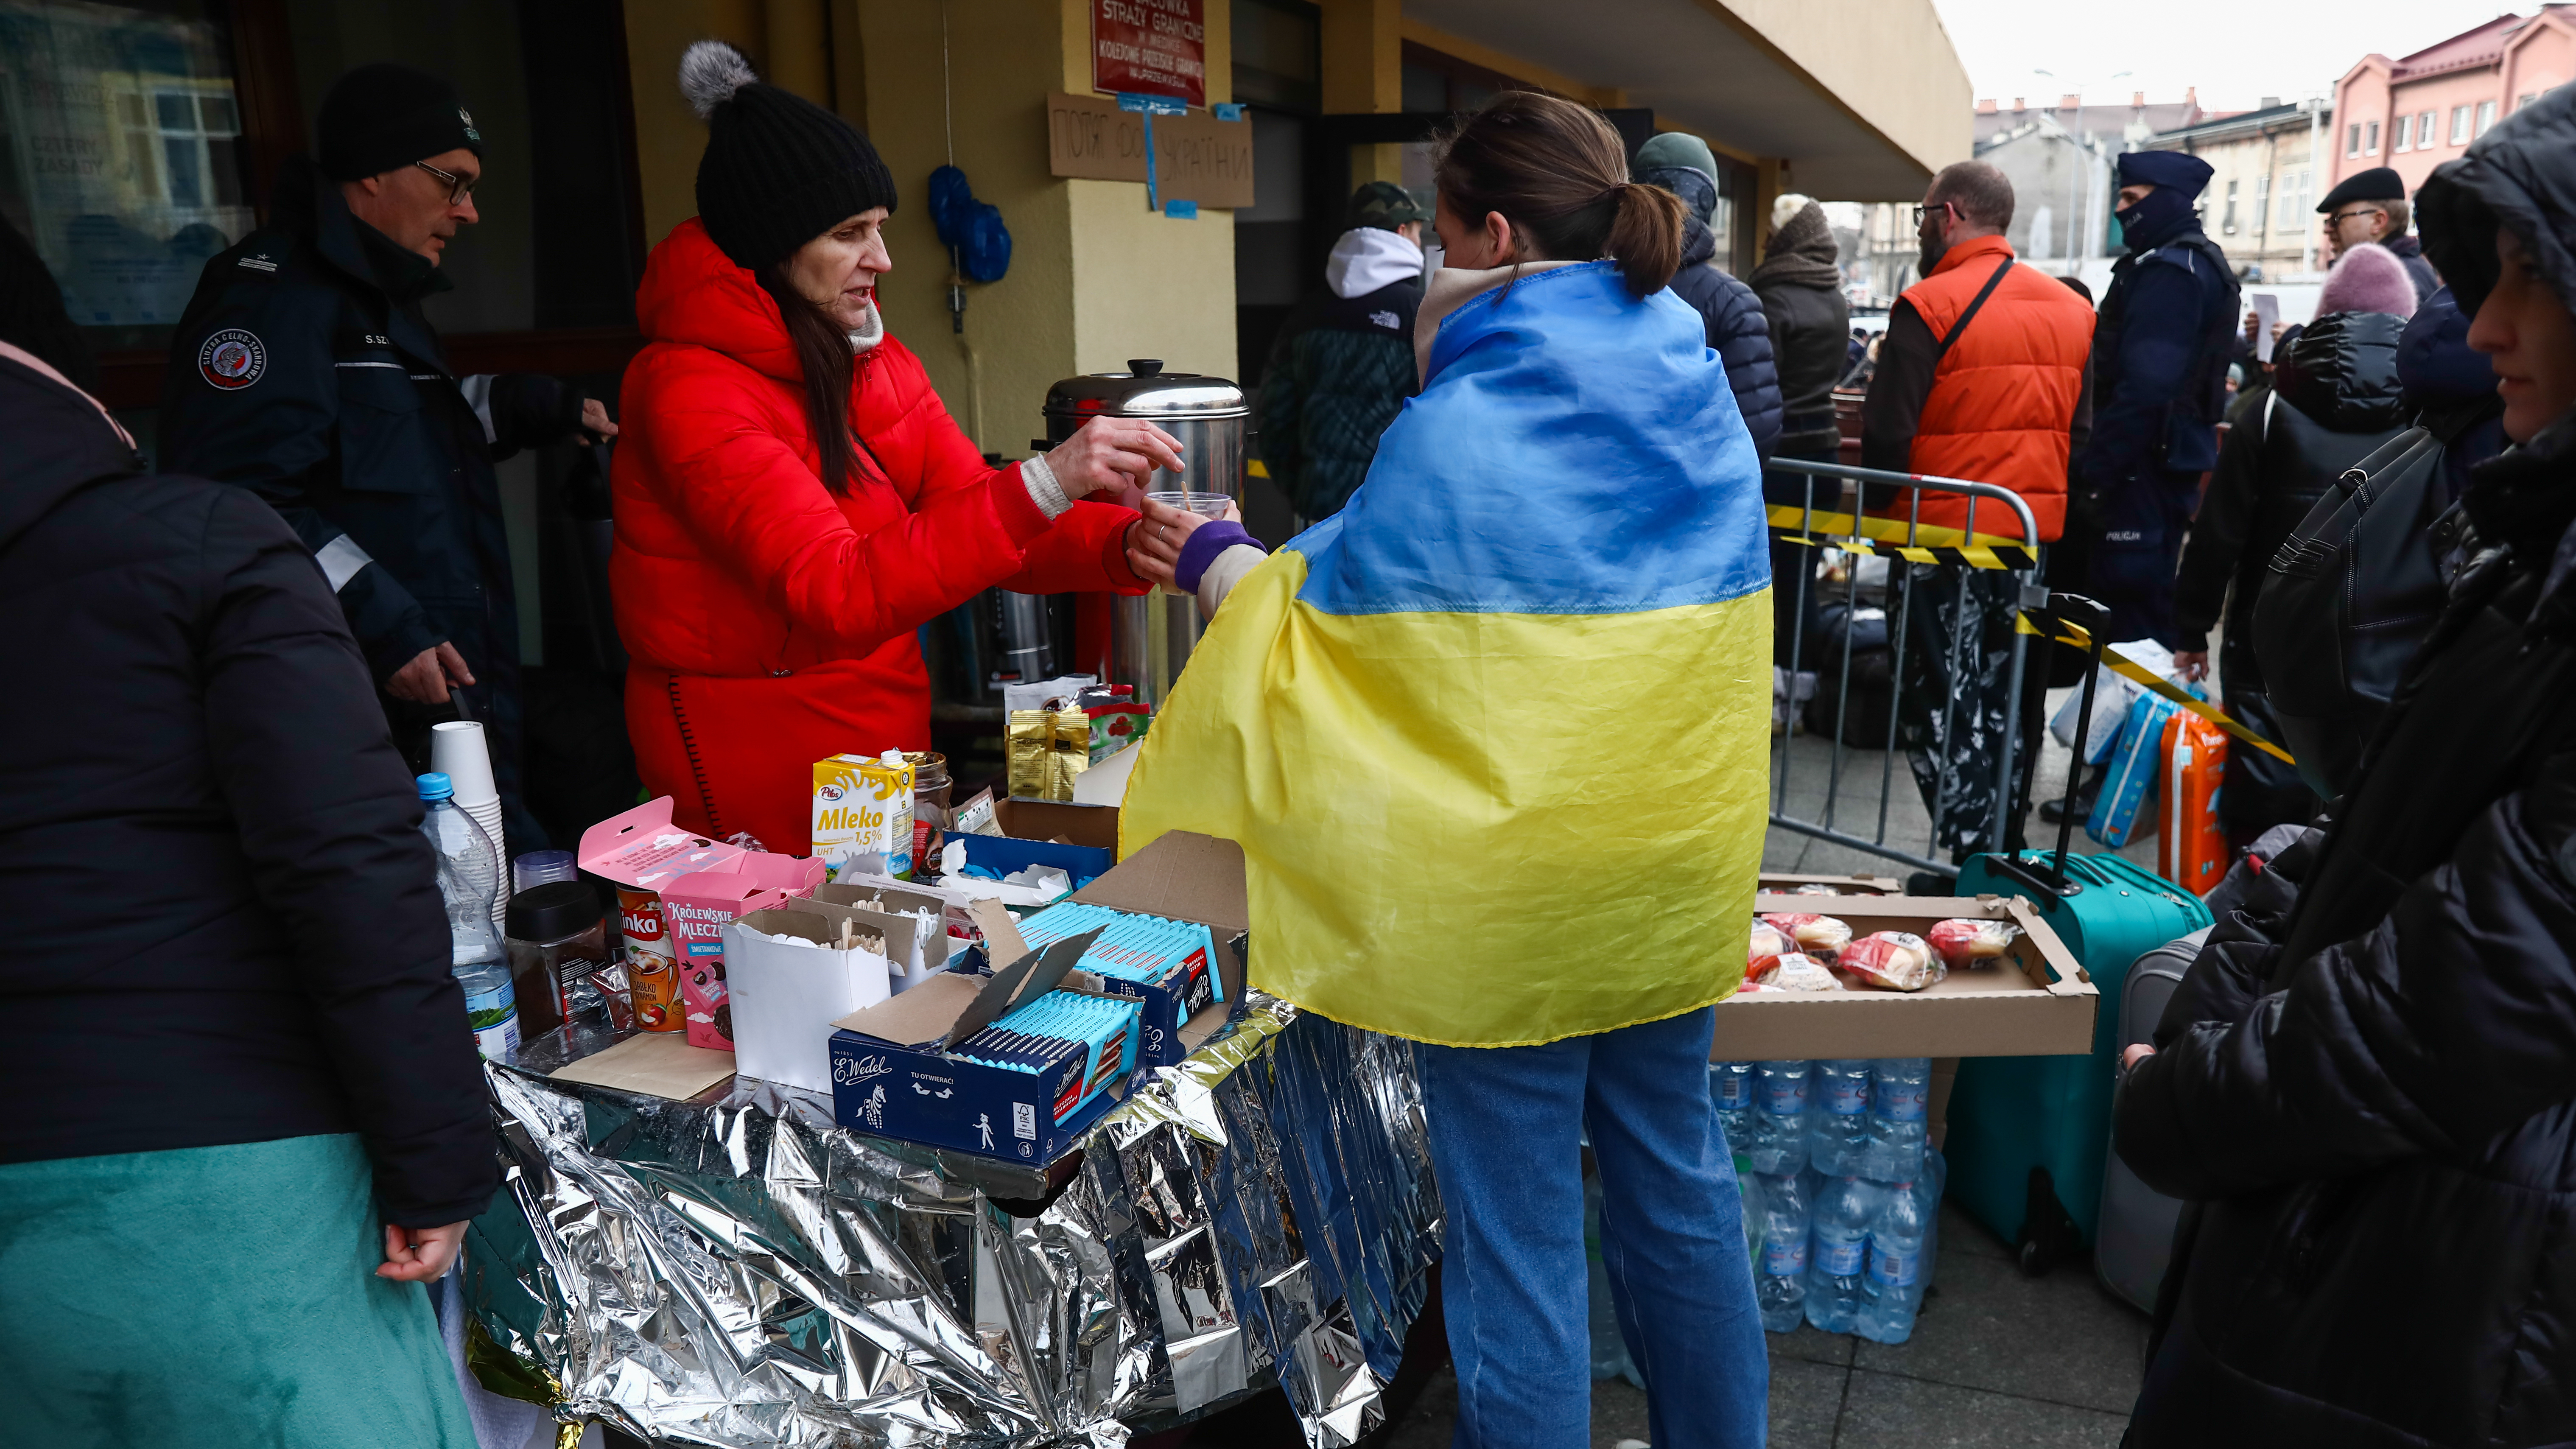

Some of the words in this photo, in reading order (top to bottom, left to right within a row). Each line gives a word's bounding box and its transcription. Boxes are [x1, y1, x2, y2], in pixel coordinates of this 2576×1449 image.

[1161, 131, 1249, 182] УКРАЇНИ
[820, 786, 839, 798] Pilos
[817, 806, 884, 831] Mleko
[855, 829, 882, 845] 1,5%
[817, 848, 834, 856] UHT
[622, 911, 657, 933] inka
[1190, 962, 1201, 971] MLECZ
[634, 981, 656, 993] JABŁKO
[1188, 974, 1209, 1013] E.Wedel
[1015, 1004, 1034, 1020] CZEKOLADA
[1026, 1006, 1045, 1021] CZEKOLADA
[1032, 1010, 1052, 1024] CZEKOLADA
[1043, 1010, 1063, 1025] CZEKOLADA
[1055, 1011, 1074, 1026] CZEKOLADA
[1000, 1017, 1016, 1030] MLECZNA
[1011, 1019, 1027, 1032] MLECZNA
[1066, 1013, 1085, 1028] CZEKOLADA
[1077, 1014, 1096, 1029] CZEKOLADA
[1085, 1017, 1104, 1032] CZEKOLADA
[1096, 1015, 1115, 1030] CZEKOLADA
[964, 1025, 990, 1045] TRUSKAWKOWA
[1018, 1022, 1034, 1035] MLECZNA
[1029, 1023, 1045, 1036] MLECZNA
[1041, 1024, 1057, 1036] MLECZNA
[1051, 1025, 1067, 1038] MLECZNA
[1063, 1026, 1079, 1039] MLECZNA
[1071, 1029, 1086, 1042] MLECZNA
[1082, 1028, 1098, 1041] MLECZNA
[975, 1027, 1001, 1047] TRUSKAWKOWA
[987, 1029, 1012, 1049] TRUSKAWKOWA
[993, 1032, 1019, 1052] TRUSKAWKOWA
[1004, 1033, 1030, 1053] TRUSKAWKOWA
[1017, 1034, 1043, 1054] TRUSKAWKOWA
[1027, 1036, 1053, 1055] TRUSKAWKOWA
[1038, 1037, 1064, 1057] TRUSKAWKOWA
[1046, 1040, 1072, 1060] TRUSKAWKOWA
[834, 1055, 892, 1085] E.Wedel
[920, 1074, 954, 1085] OTWIERAĆ!
[1053, 1094, 1073, 1112] MLECZNA
[1053, 1095, 1078, 1116] SKAWKOWA
